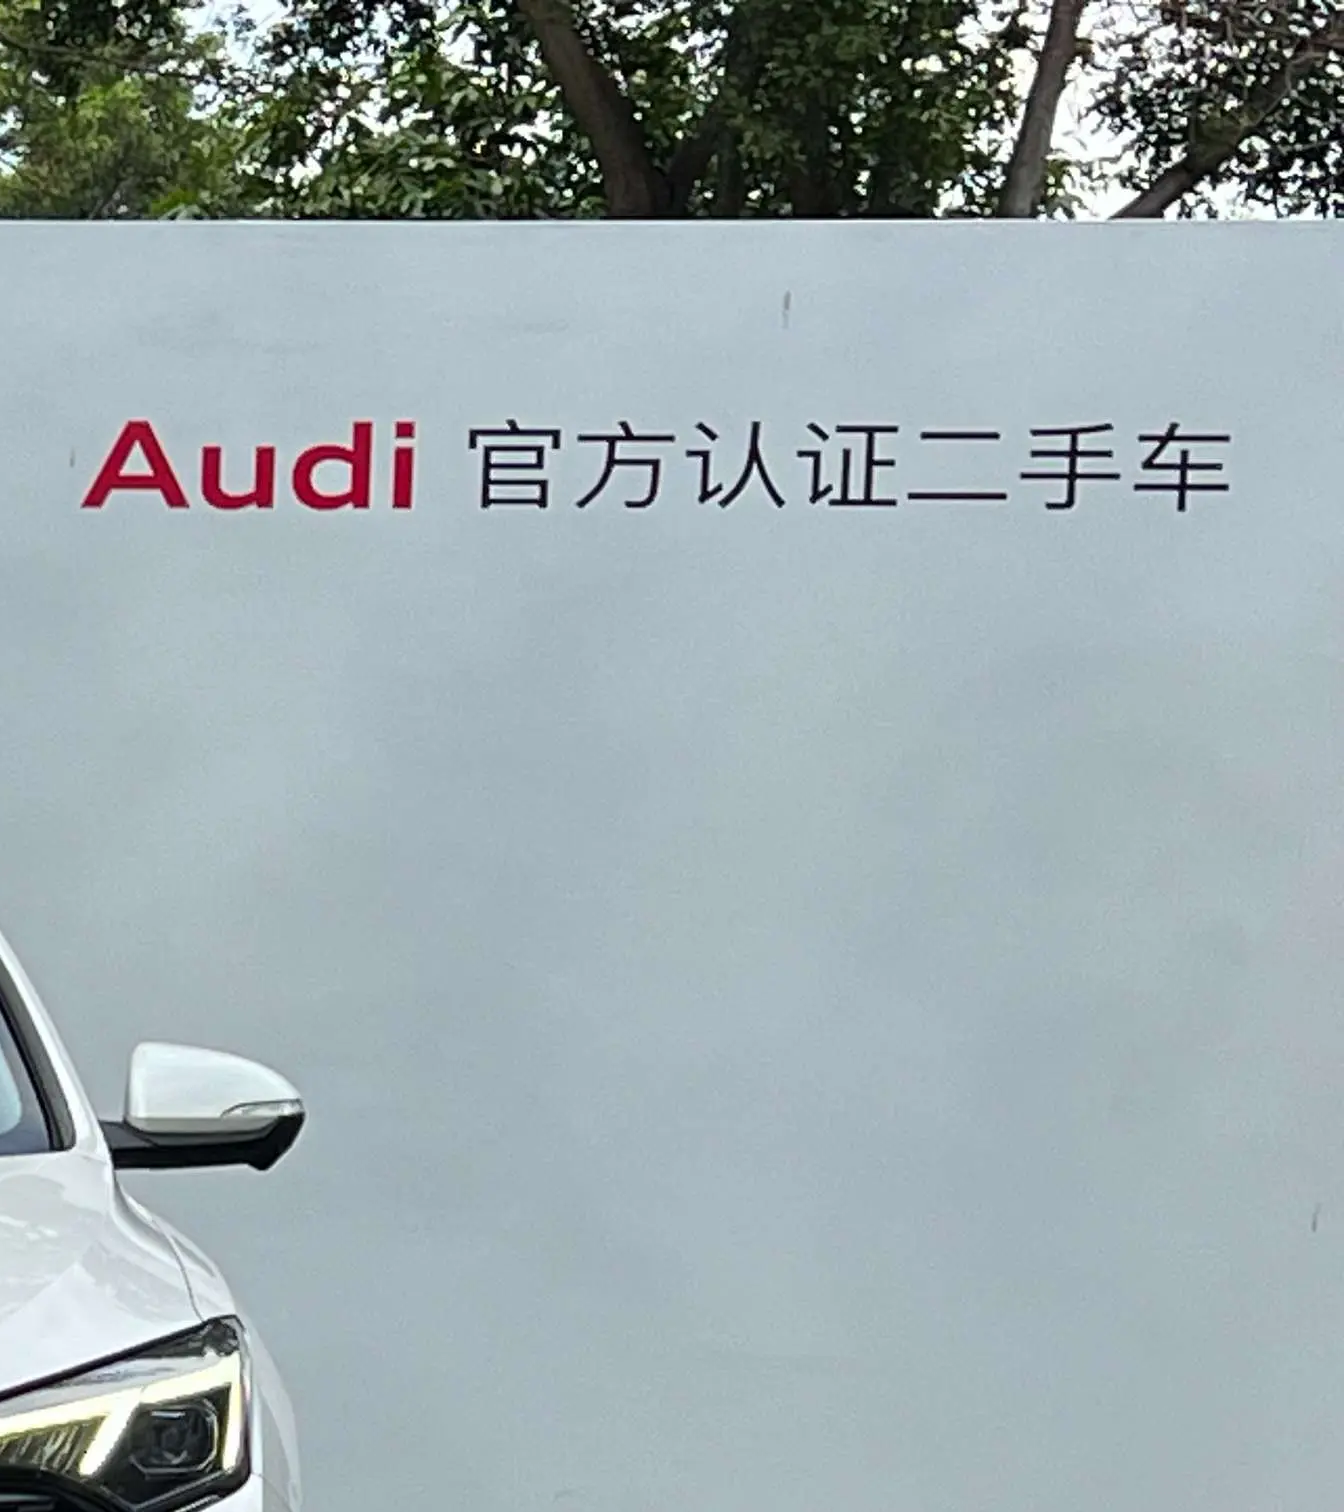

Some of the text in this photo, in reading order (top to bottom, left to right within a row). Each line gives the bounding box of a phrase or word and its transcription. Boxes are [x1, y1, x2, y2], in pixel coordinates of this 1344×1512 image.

[84, 420, 1232, 514] Audi 官方认证二手车
